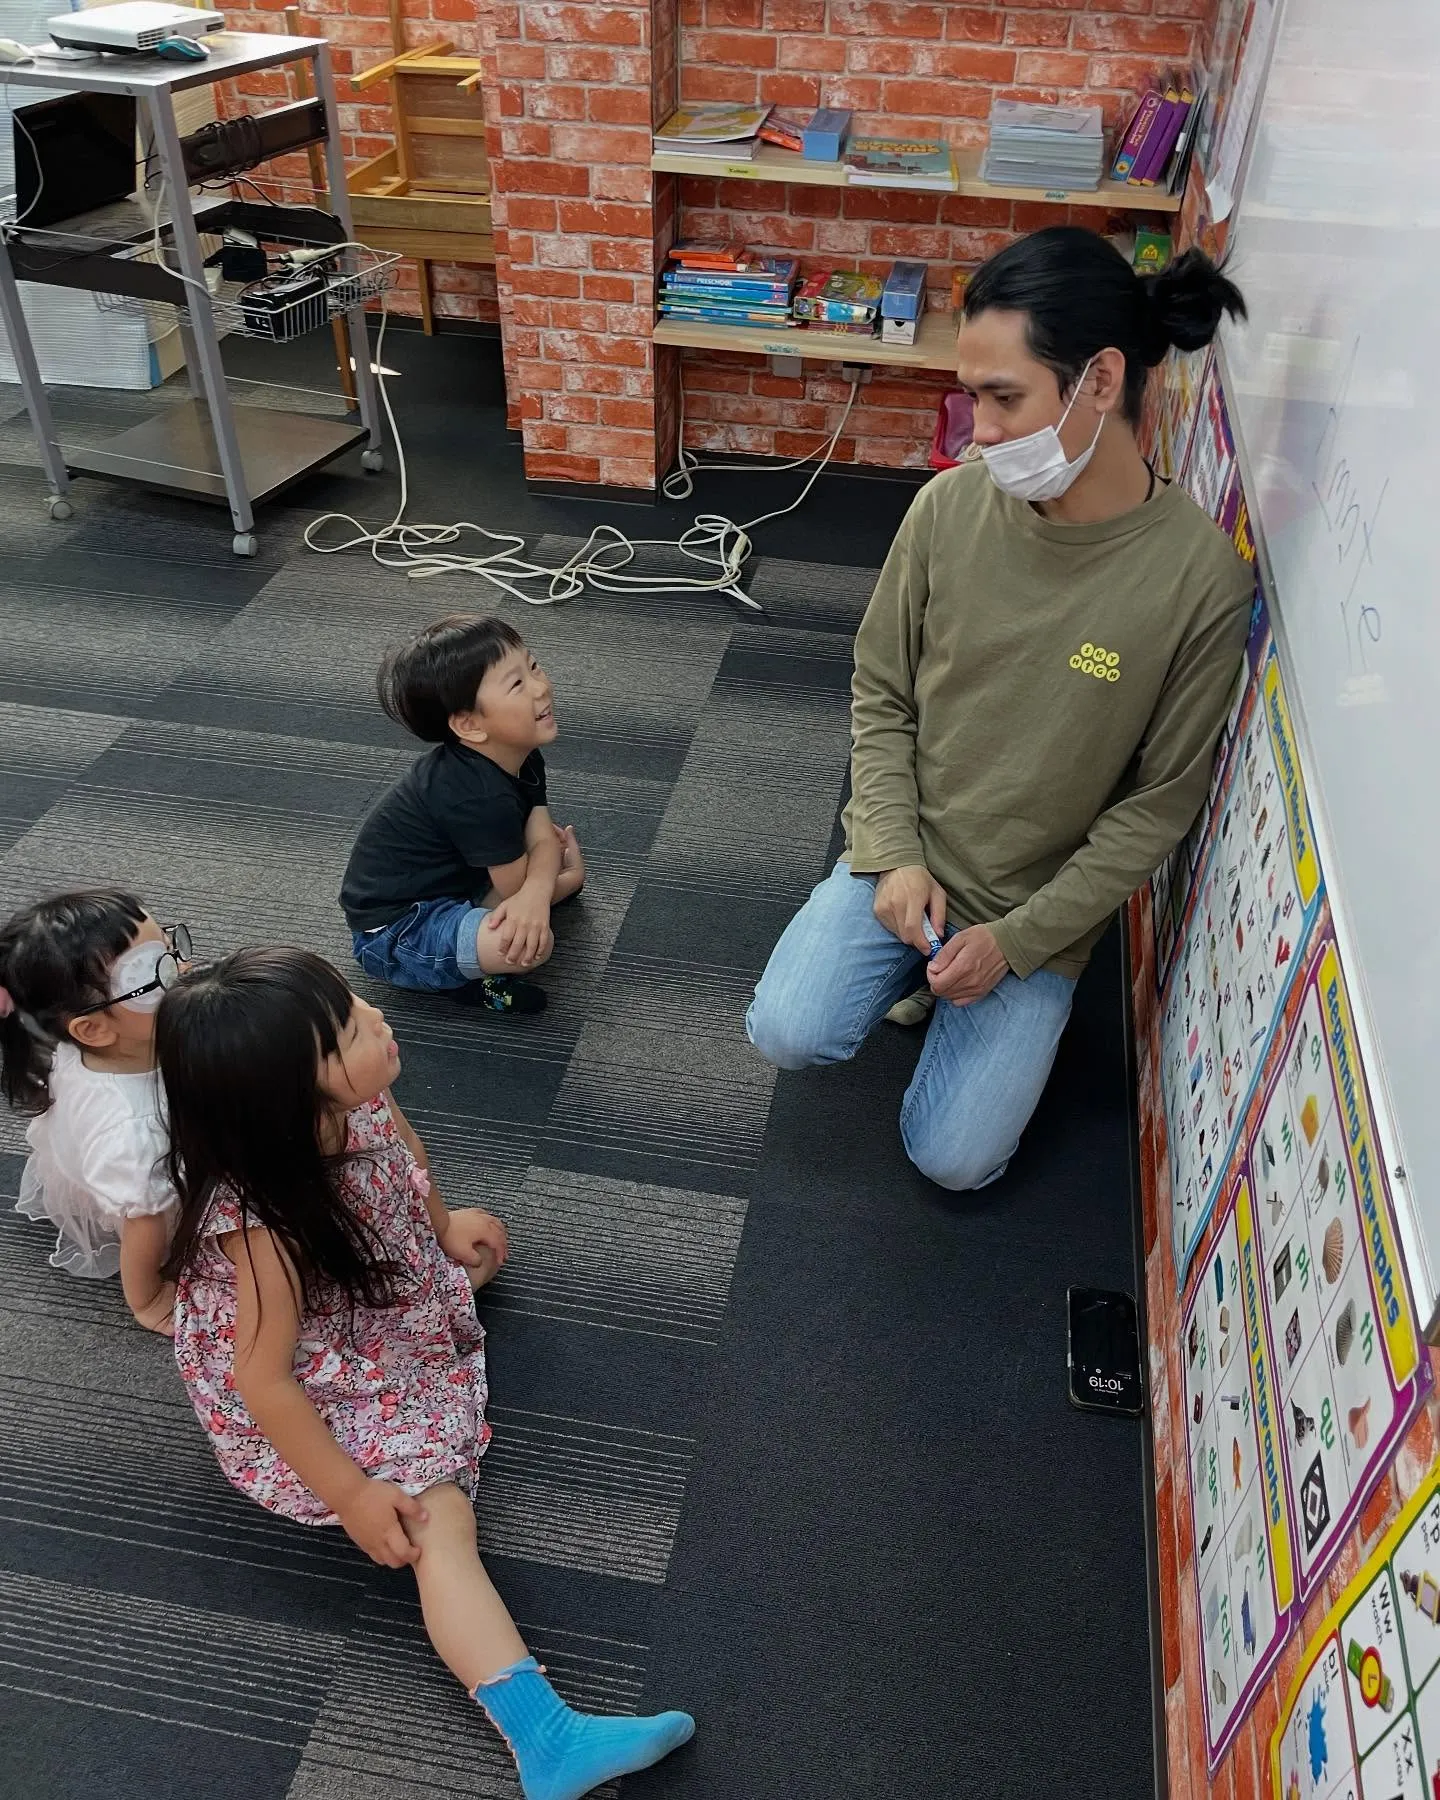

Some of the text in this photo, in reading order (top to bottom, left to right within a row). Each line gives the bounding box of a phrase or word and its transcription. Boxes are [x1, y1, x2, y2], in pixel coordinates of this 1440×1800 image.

[1083, 645, 1118, 664] SKY
[1270, 687, 1295, 788] Beginning
[1310, 1034, 1323, 1074] ch
[1280, 1113, 1293, 1163] wh
[1327, 976, 1399, 1328] Beginning Digraphs
[1334, 1160, 1348, 1206] sh
[1229, 1260, 1239, 1297] ch
[1294, 1243, 1311, 1293] ph
[1198, 1328, 1209, 1371] ng
[1359, 1312, 1376, 1366] th
[1088, 1376, 1124, 1391] 10:19
[1243, 1235, 1281, 1527] Ending Digraphs
[1241, 1387, 1251, 1428] sh
[1320, 1396, 1337, 1451] qu
[1207, 1446, 1218, 1509] dge
[1420, 1521, 1431, 1555] pen
[1430, 1502, 1440, 1544] Pp
[1255, 1535, 1266, 1582] th
[1218, 1593, 1231, 1659] tch
[1377, 1581, 1393, 1635] Ww
[1320, 1659, 1333, 1694] blue
[1328, 1647, 1340, 1679] bl
[1393, 1741, 1404, 1787] x-ray
[1401, 1724, 1414, 1774] Xx
